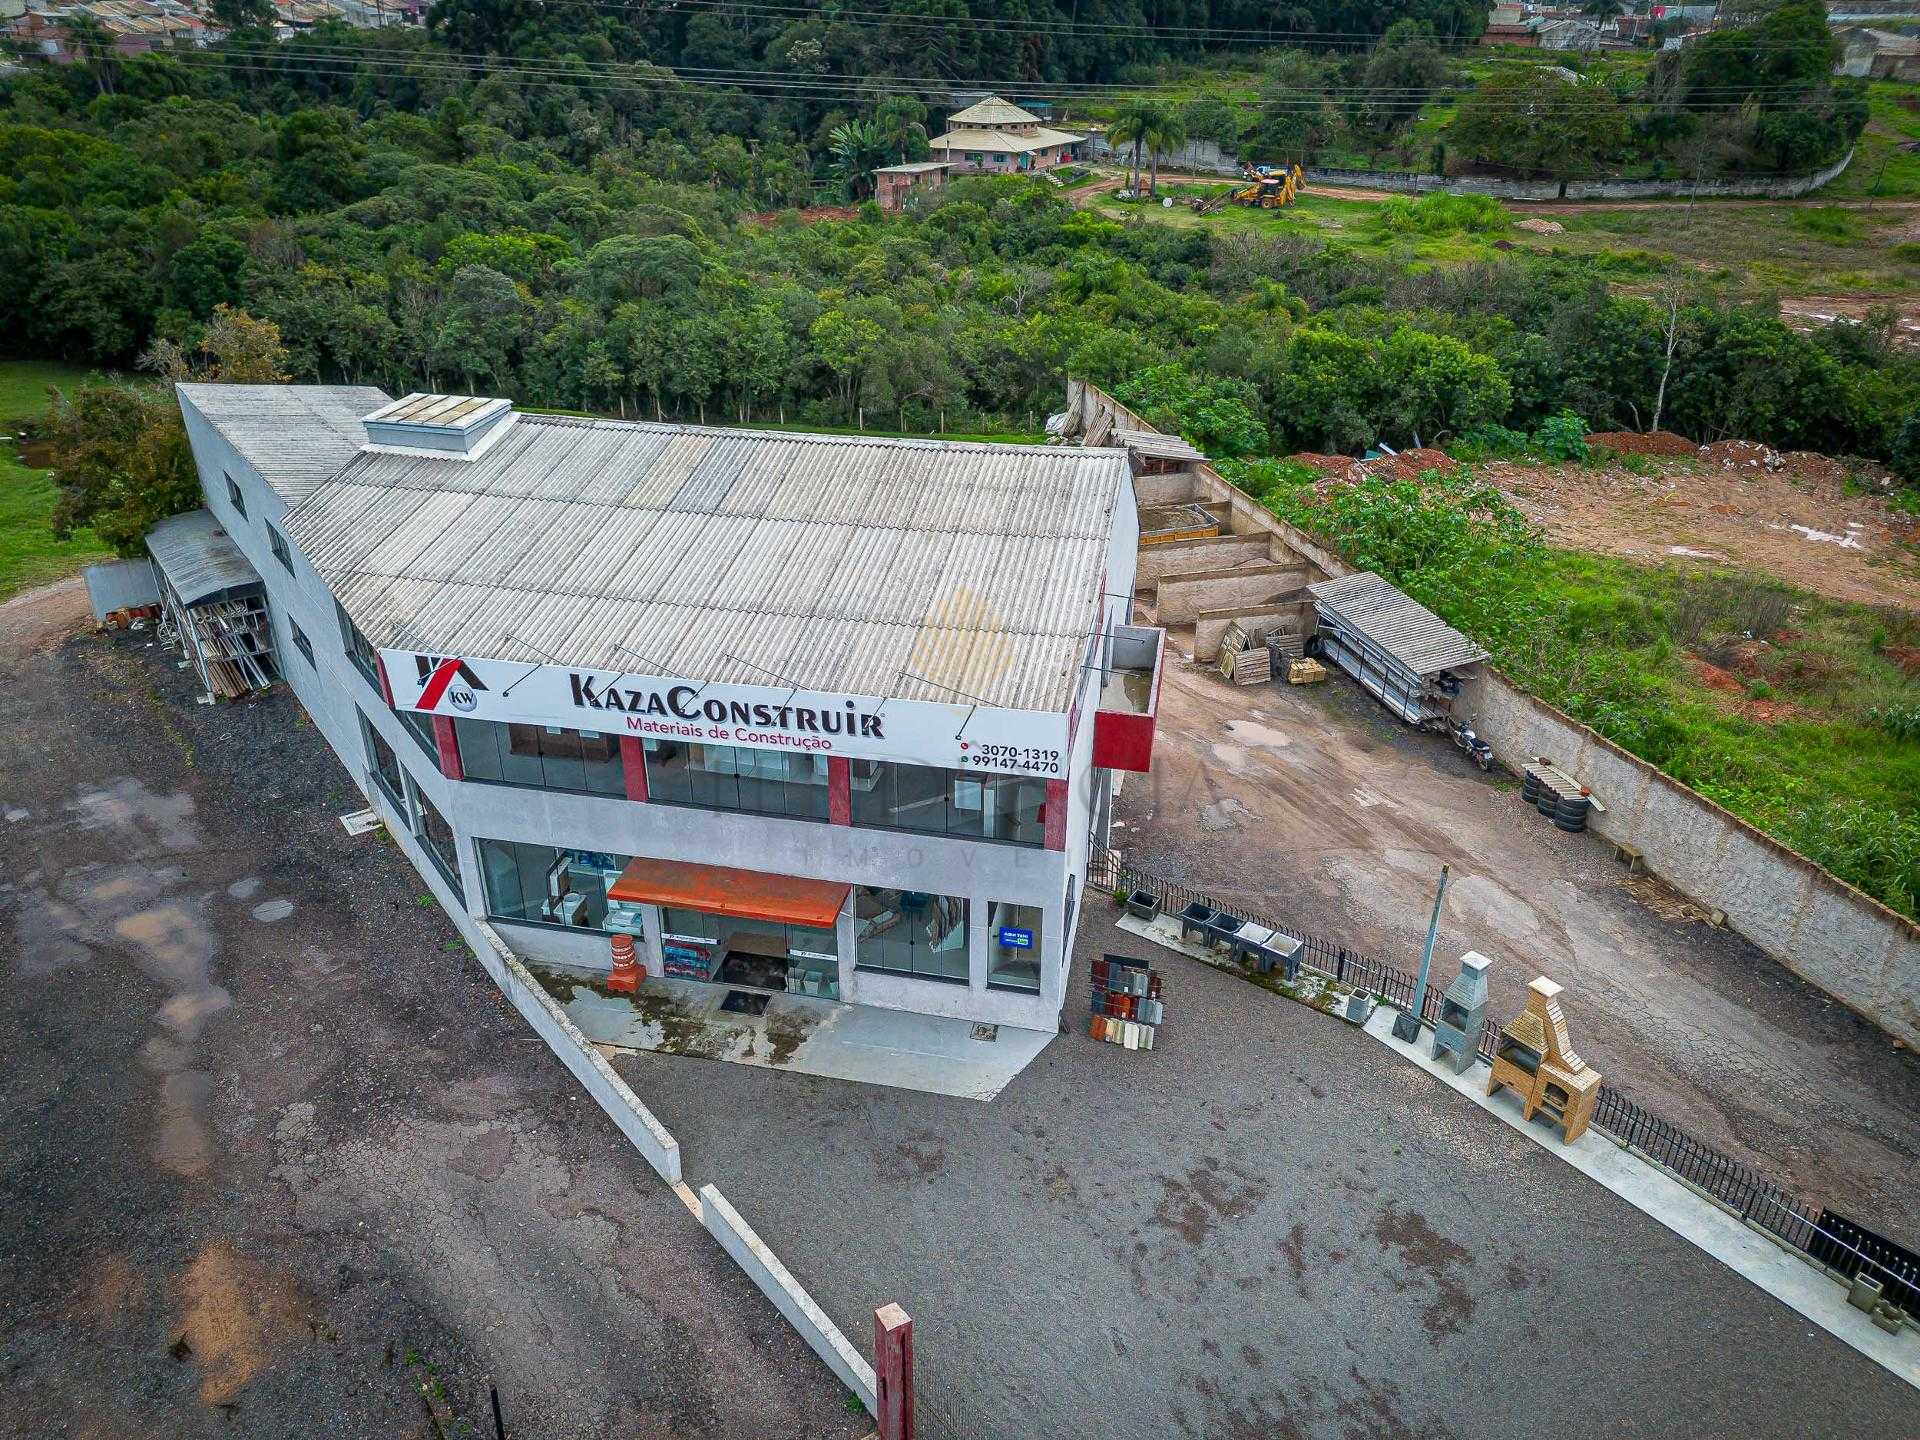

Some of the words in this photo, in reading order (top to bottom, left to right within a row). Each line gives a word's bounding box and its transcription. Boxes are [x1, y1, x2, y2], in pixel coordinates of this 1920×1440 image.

[450, 691, 474, 704] KW
[626, 716, 703, 738] Materiais
[707, 725, 730, 740] de
[734, 726, 832, 751] Construção
[981, 744, 1059, 762] 3070-1319
[972, 755, 1059, 774] 99147-4470
